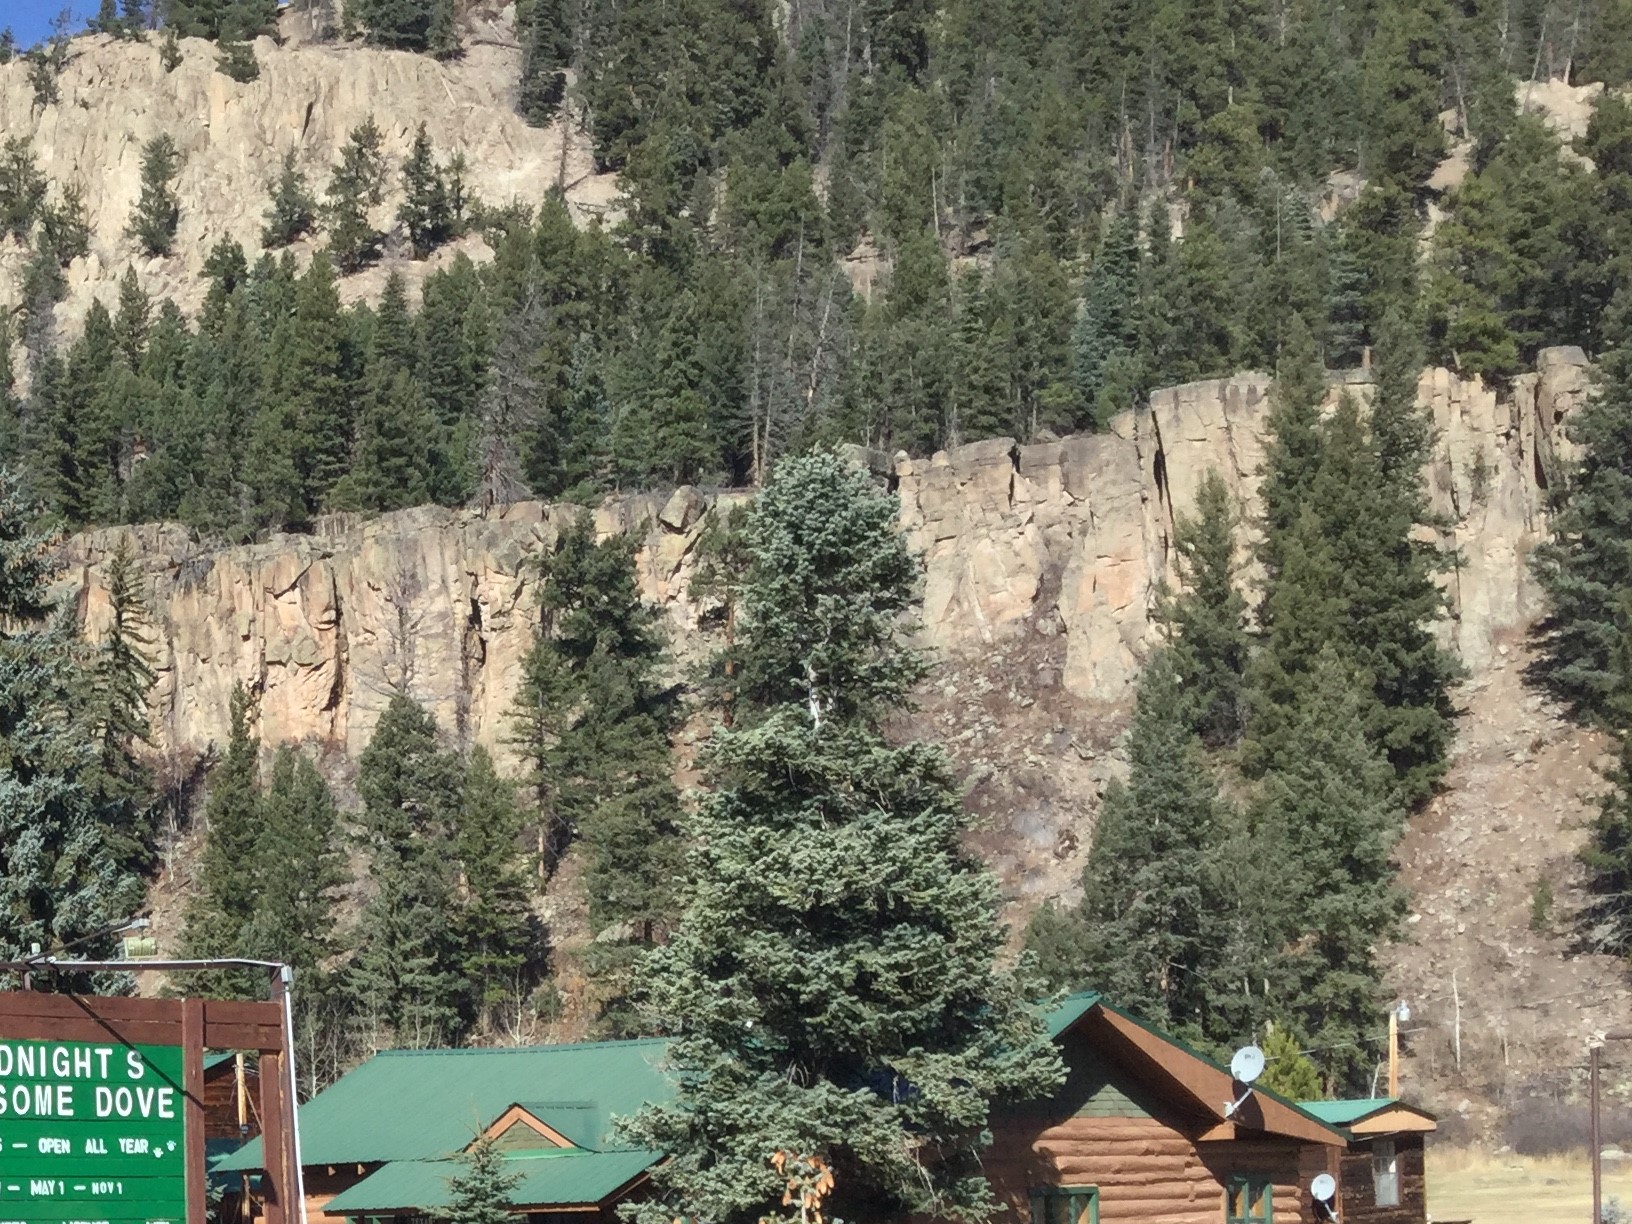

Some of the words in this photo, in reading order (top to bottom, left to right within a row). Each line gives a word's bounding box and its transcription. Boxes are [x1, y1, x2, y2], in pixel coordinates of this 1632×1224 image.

[95, 1086, 175, 1119] DOVE
[38, 1137, 71, 1155] OPEN
[85, 1138, 108, 1154] ALL
[118, 1138, 149, 1154] YEAR
[30, 1179, 56, 1196] MAY
[58, 1181, 65, 1195] 1
[91, 1181, 114, 1195] NOV
[116, 1182, 123, 1195] 1
